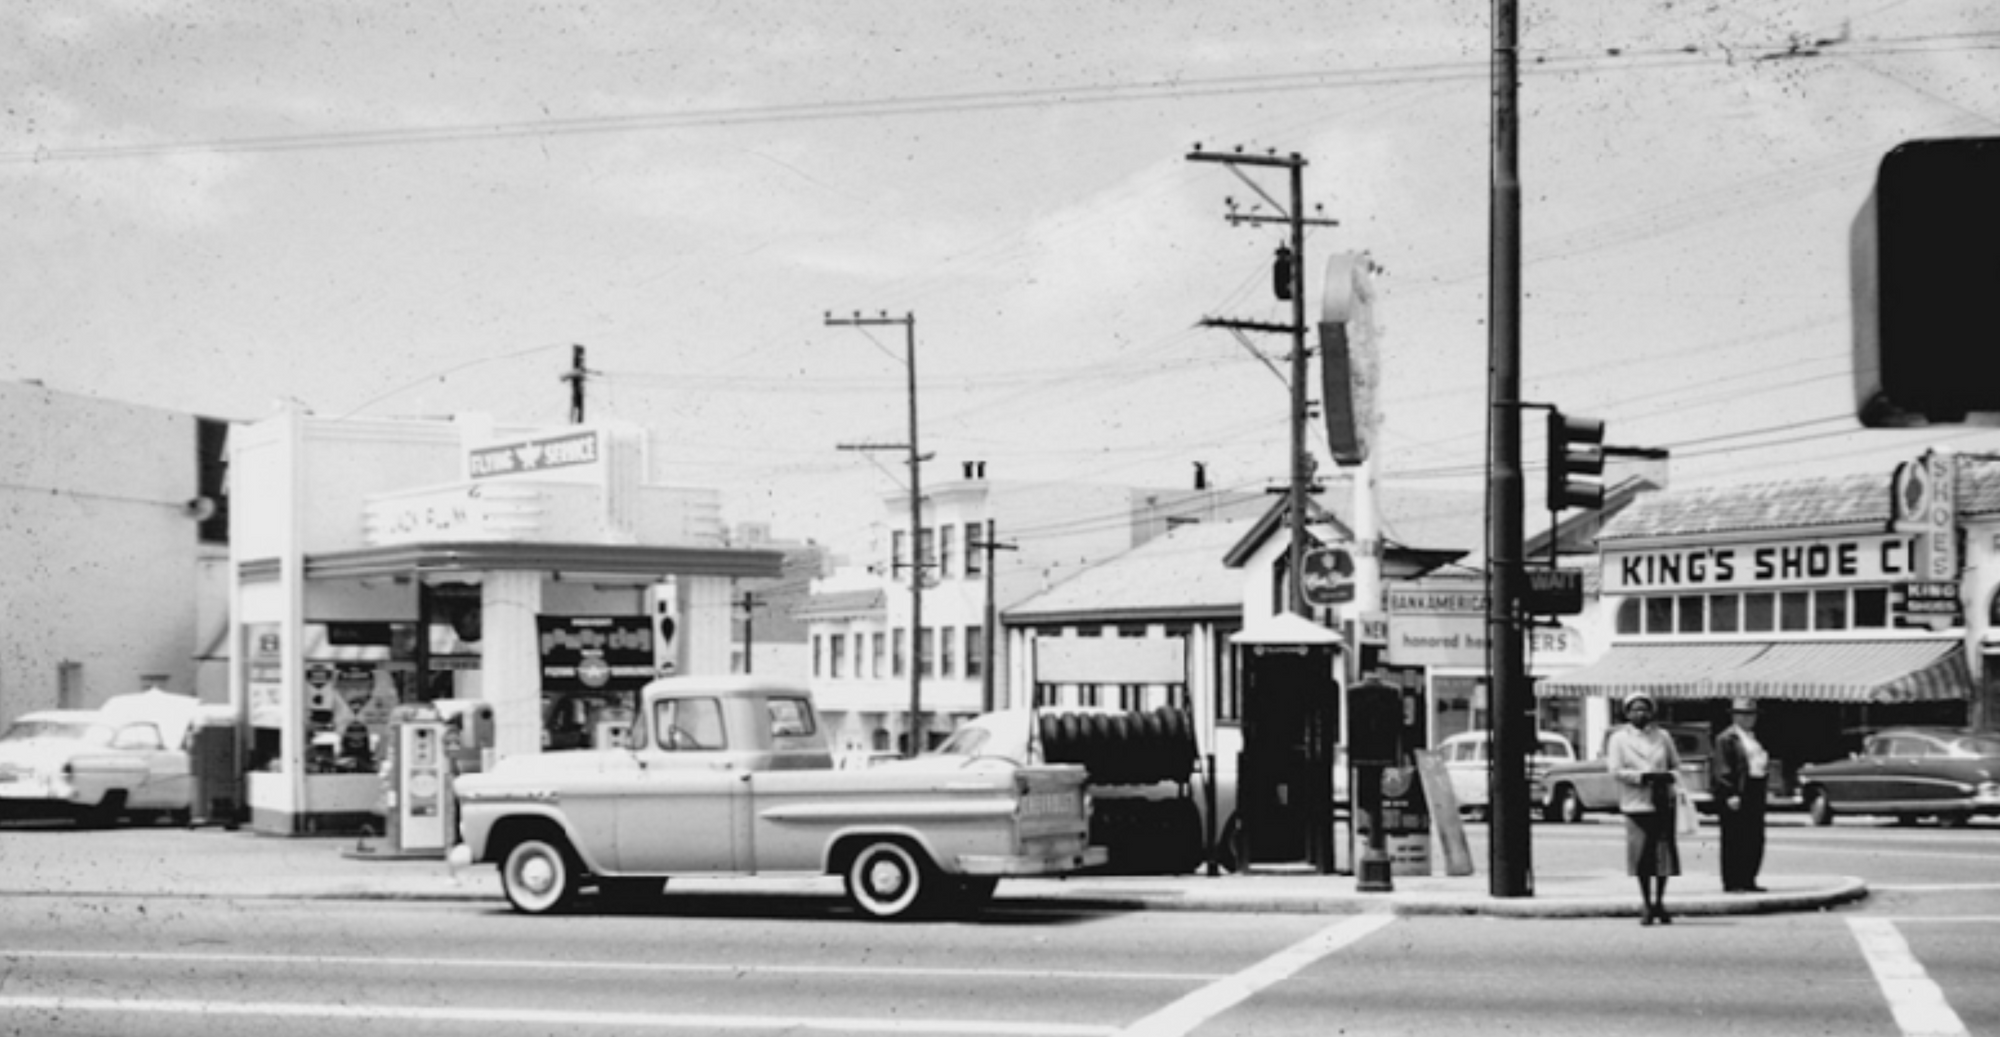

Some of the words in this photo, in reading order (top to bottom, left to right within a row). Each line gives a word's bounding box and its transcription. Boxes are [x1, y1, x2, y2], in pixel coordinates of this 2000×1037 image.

[471, 448, 514, 475] FLYING
[544, 437, 595, 466] SERVICE
[1933, 459, 1949, 576] SHOES
[1530, 572, 1575, 590] WAIT
[1621, 548, 1735, 585] KING'S
[1754, 543, 1858, 580] SHOE
[1908, 584, 1956, 598] KING
